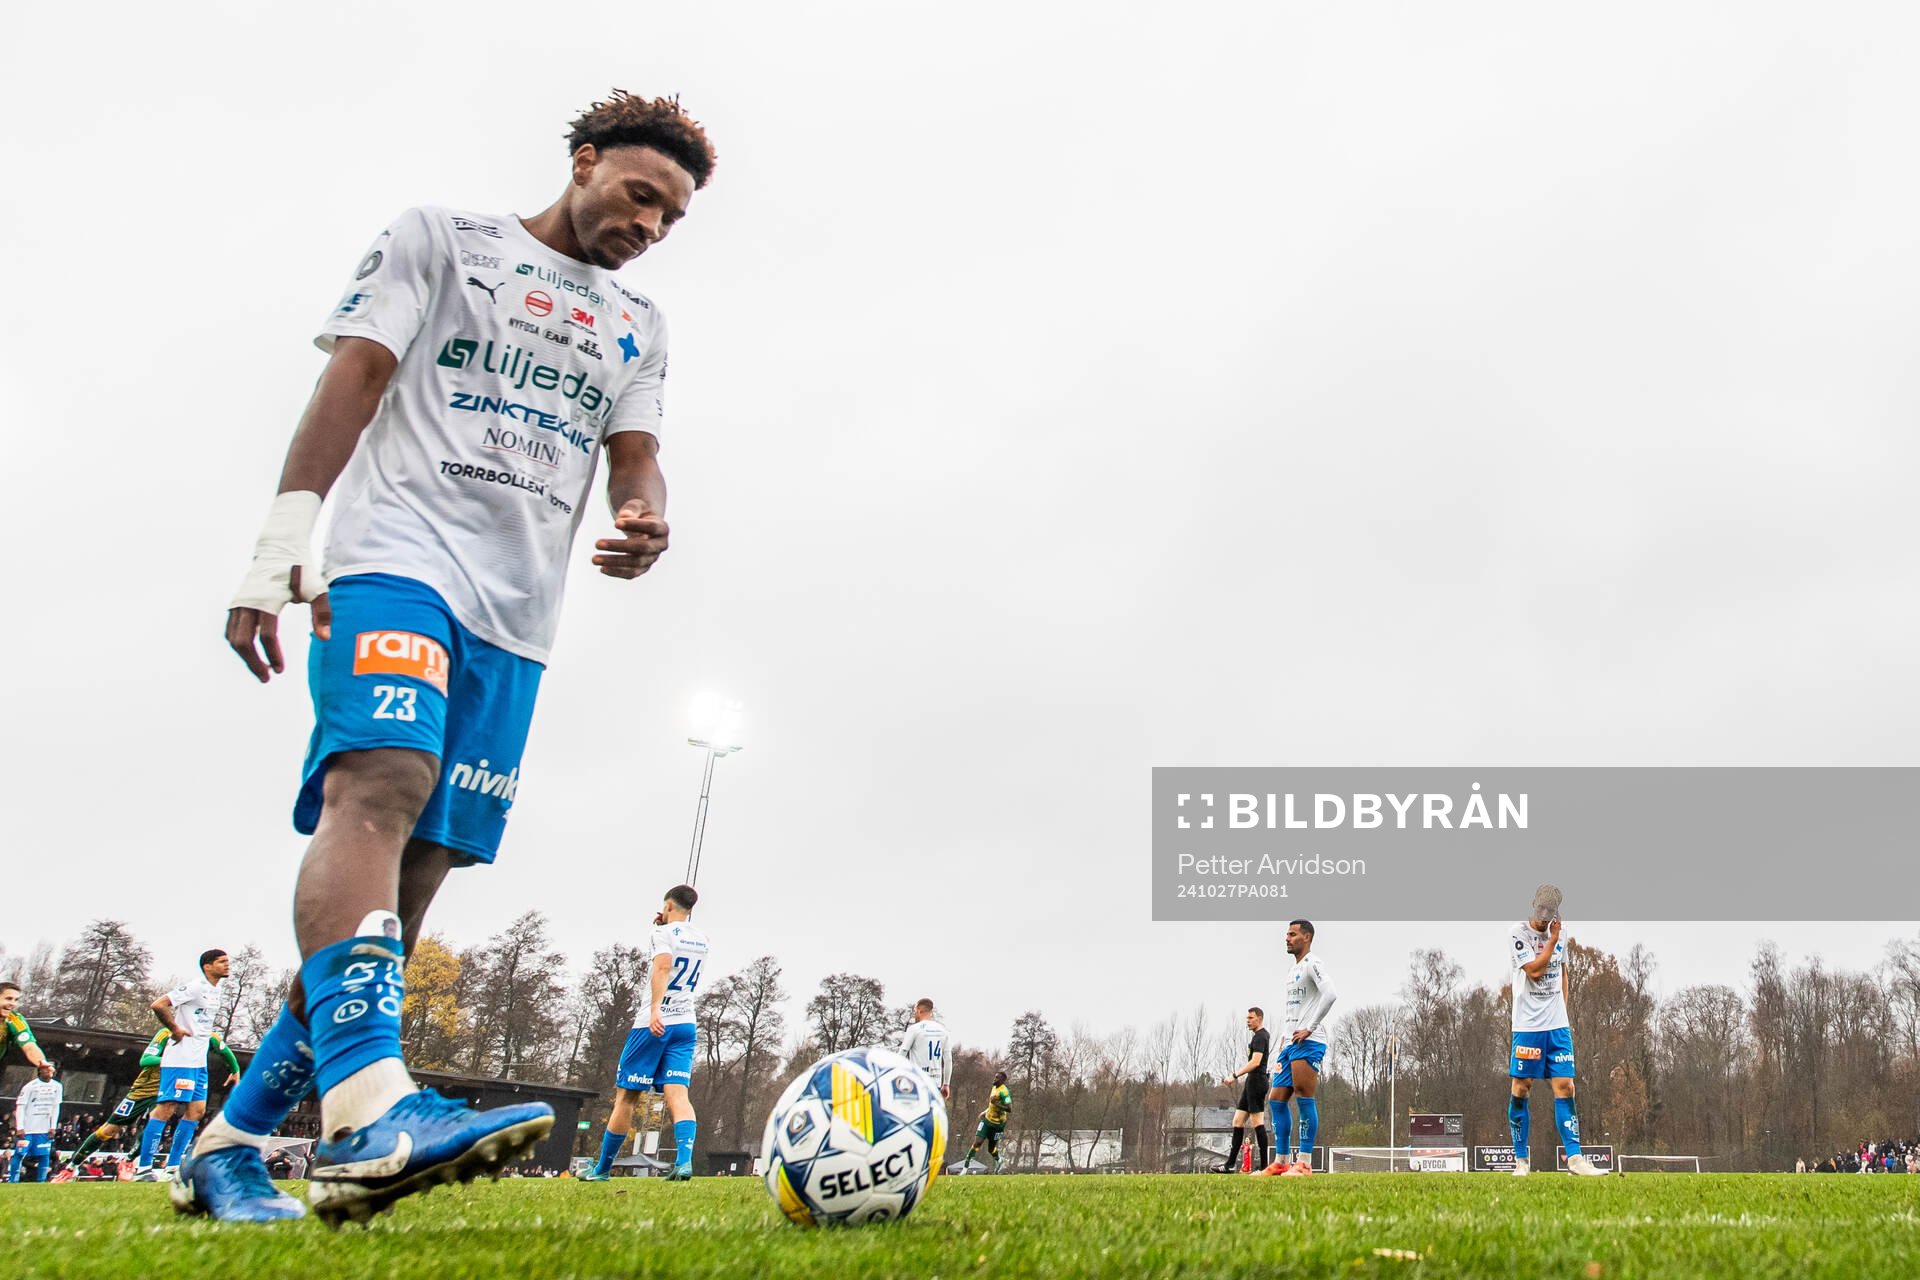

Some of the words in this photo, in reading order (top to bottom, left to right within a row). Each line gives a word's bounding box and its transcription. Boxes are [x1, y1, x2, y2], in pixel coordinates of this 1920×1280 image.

[570, 307, 595, 328] 3M
[544, 330, 570, 346] EAB
[440, 461, 545, 497] TORRBOLLEN
[359, 632, 450, 670] ram
[372, 685, 418, 722] 23
[667, 956, 702, 993] 24
[928, 1041, 941, 1060] 14
[1517, 1061, 1523, 1070] 5
[820, 1144, 915, 1201] SELECT
